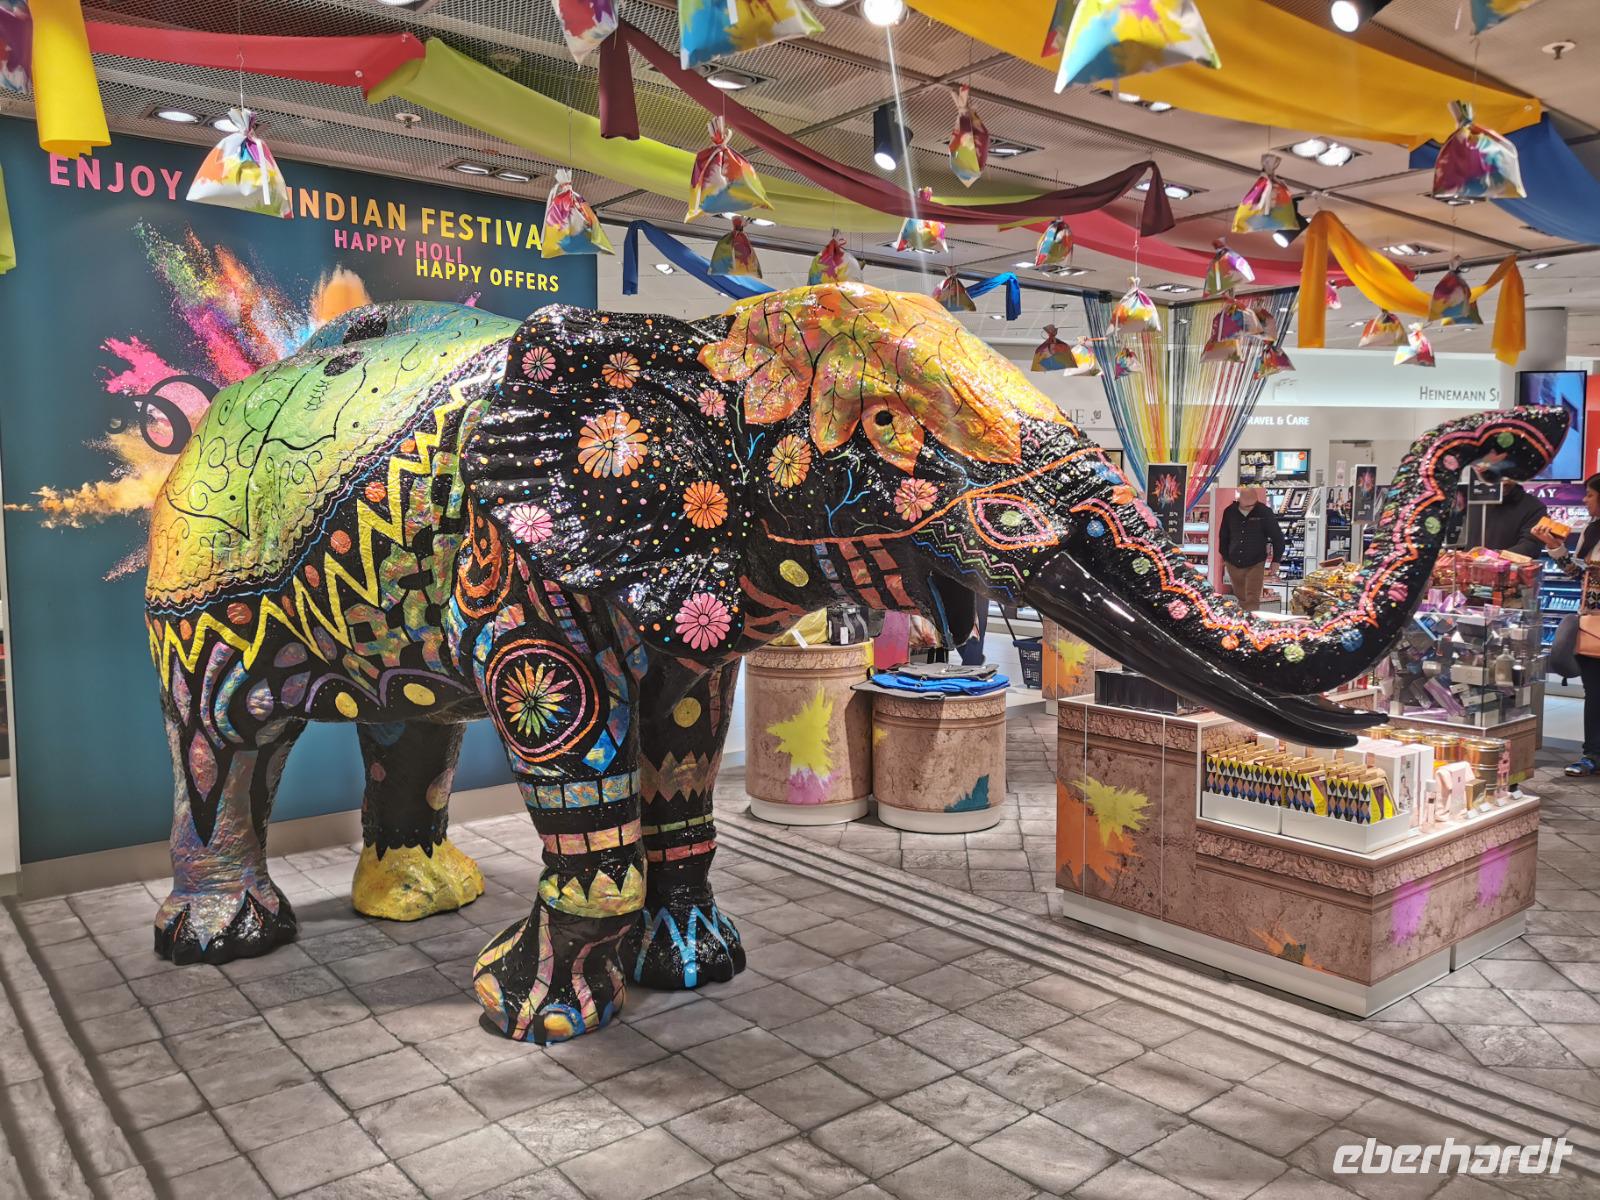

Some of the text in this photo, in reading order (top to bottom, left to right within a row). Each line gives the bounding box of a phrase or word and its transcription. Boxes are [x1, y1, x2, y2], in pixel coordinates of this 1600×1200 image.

[49, 152, 183, 201] ENJOY
[421, 207, 542, 251] FESTIVA
[334, 229, 462, 264] HAPPY HOLI
[416, 258, 559, 292] HAPPY OFFERS
[1419, 386, 1486, 401] HEINEMANN
[1286, 414, 1311, 426] CARE
